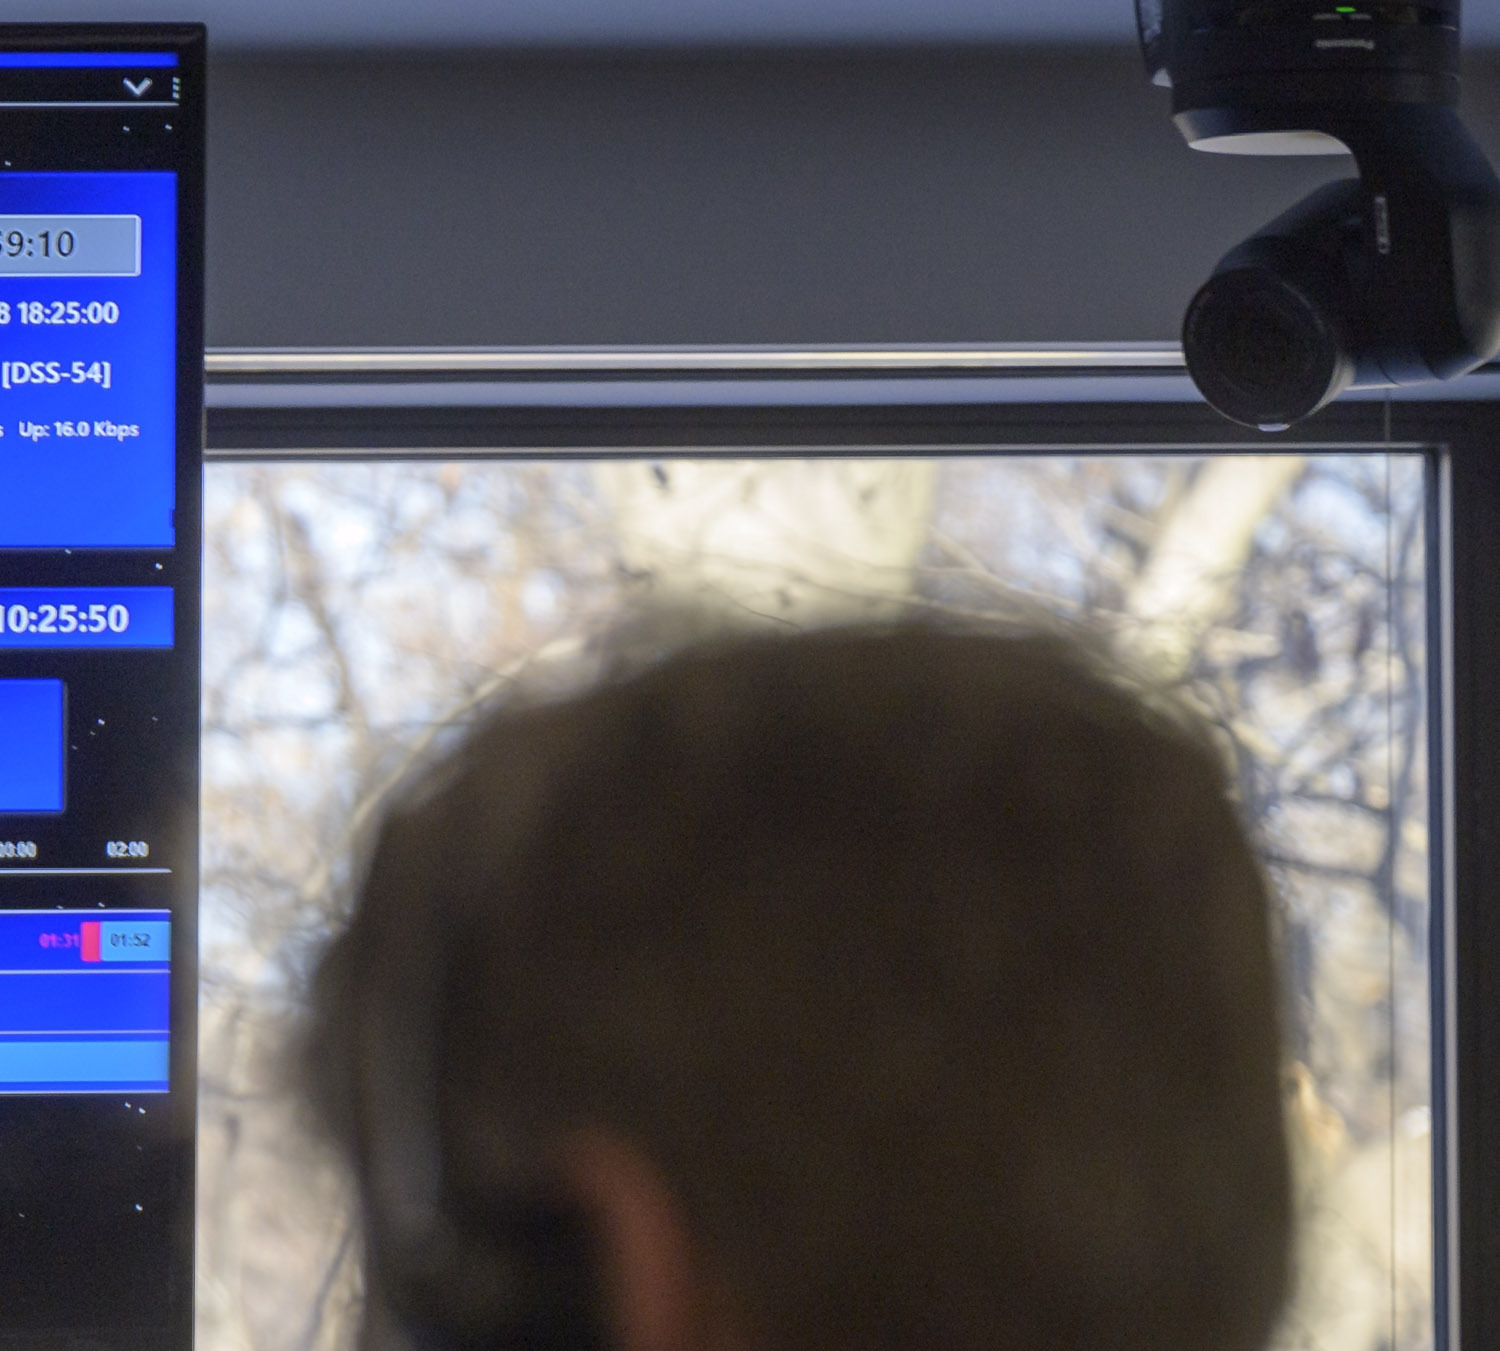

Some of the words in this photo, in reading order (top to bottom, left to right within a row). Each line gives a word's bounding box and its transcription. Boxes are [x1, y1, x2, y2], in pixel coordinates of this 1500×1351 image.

[18, 302, 119, 327] 18:25:00
[2, 361, 112, 390] [DSS-54]
[53, 421, 91, 438] 16.0
[92, 420, 140, 442] Kbps
[106, 840, 150, 858] 02:00
